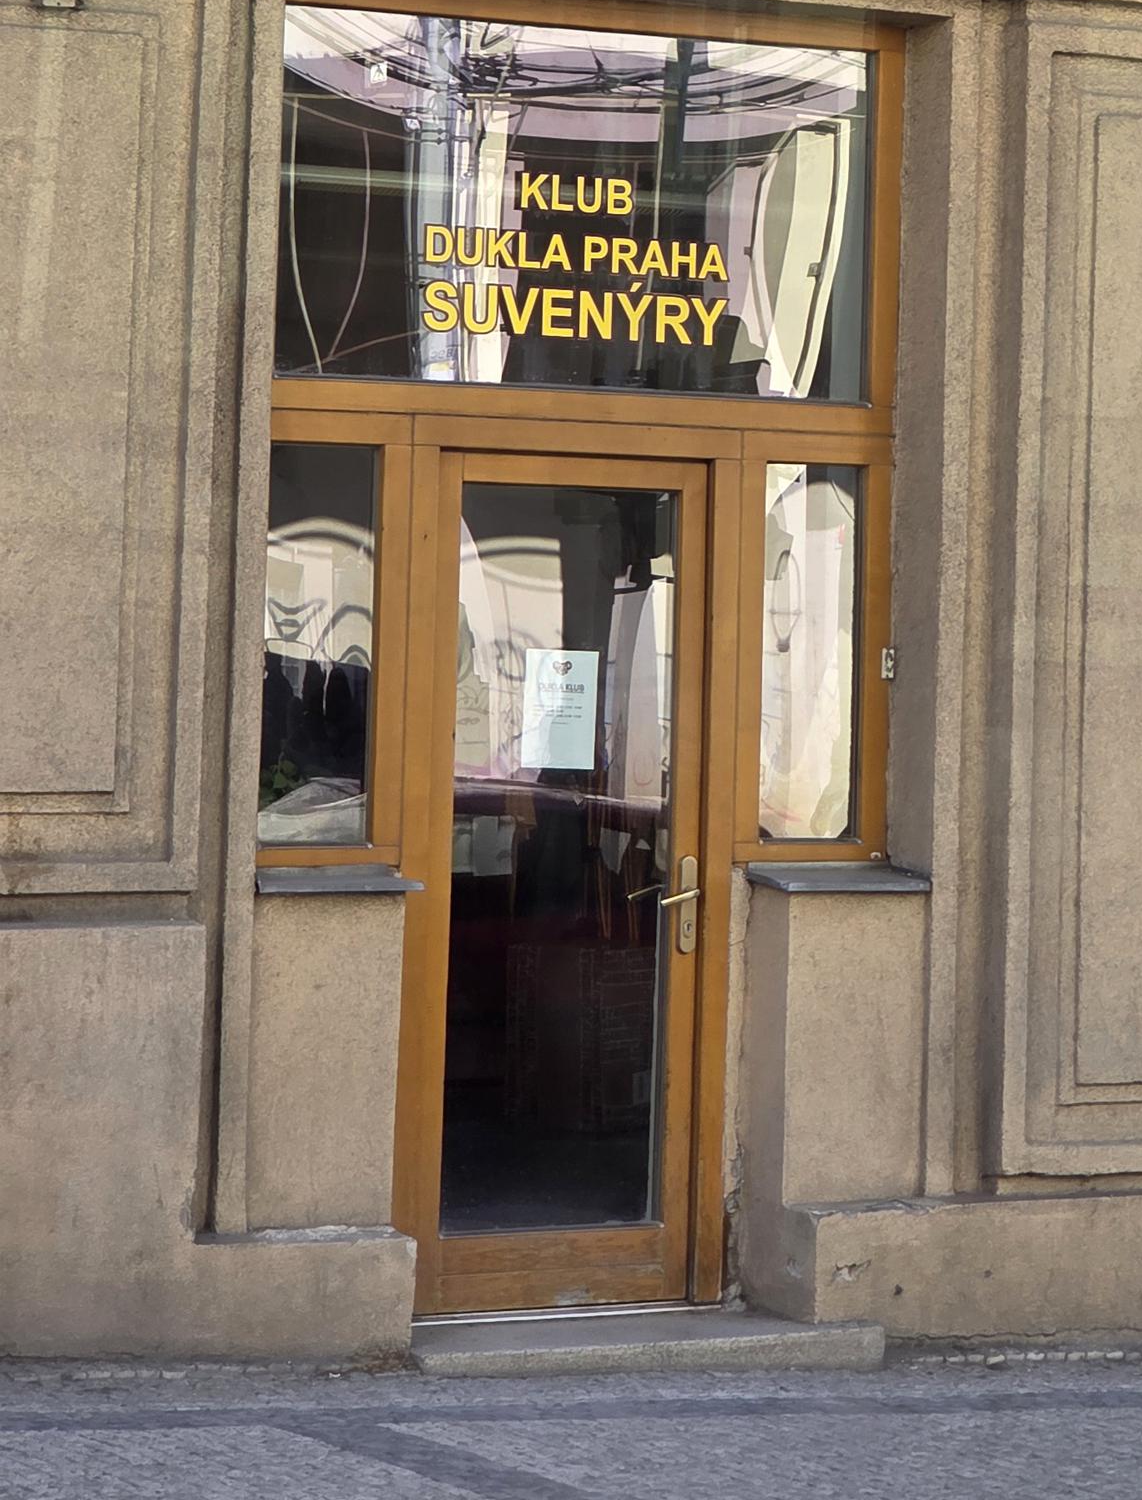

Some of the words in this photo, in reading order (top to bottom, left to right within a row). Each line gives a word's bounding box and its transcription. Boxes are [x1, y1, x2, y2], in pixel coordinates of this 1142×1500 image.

[519, 171, 634, 217] KLUB
[423, 223, 570, 273] DUKLA
[583, 234, 730, 283] PRAHA
[421, 280, 729, 348] SUVENÝRY
